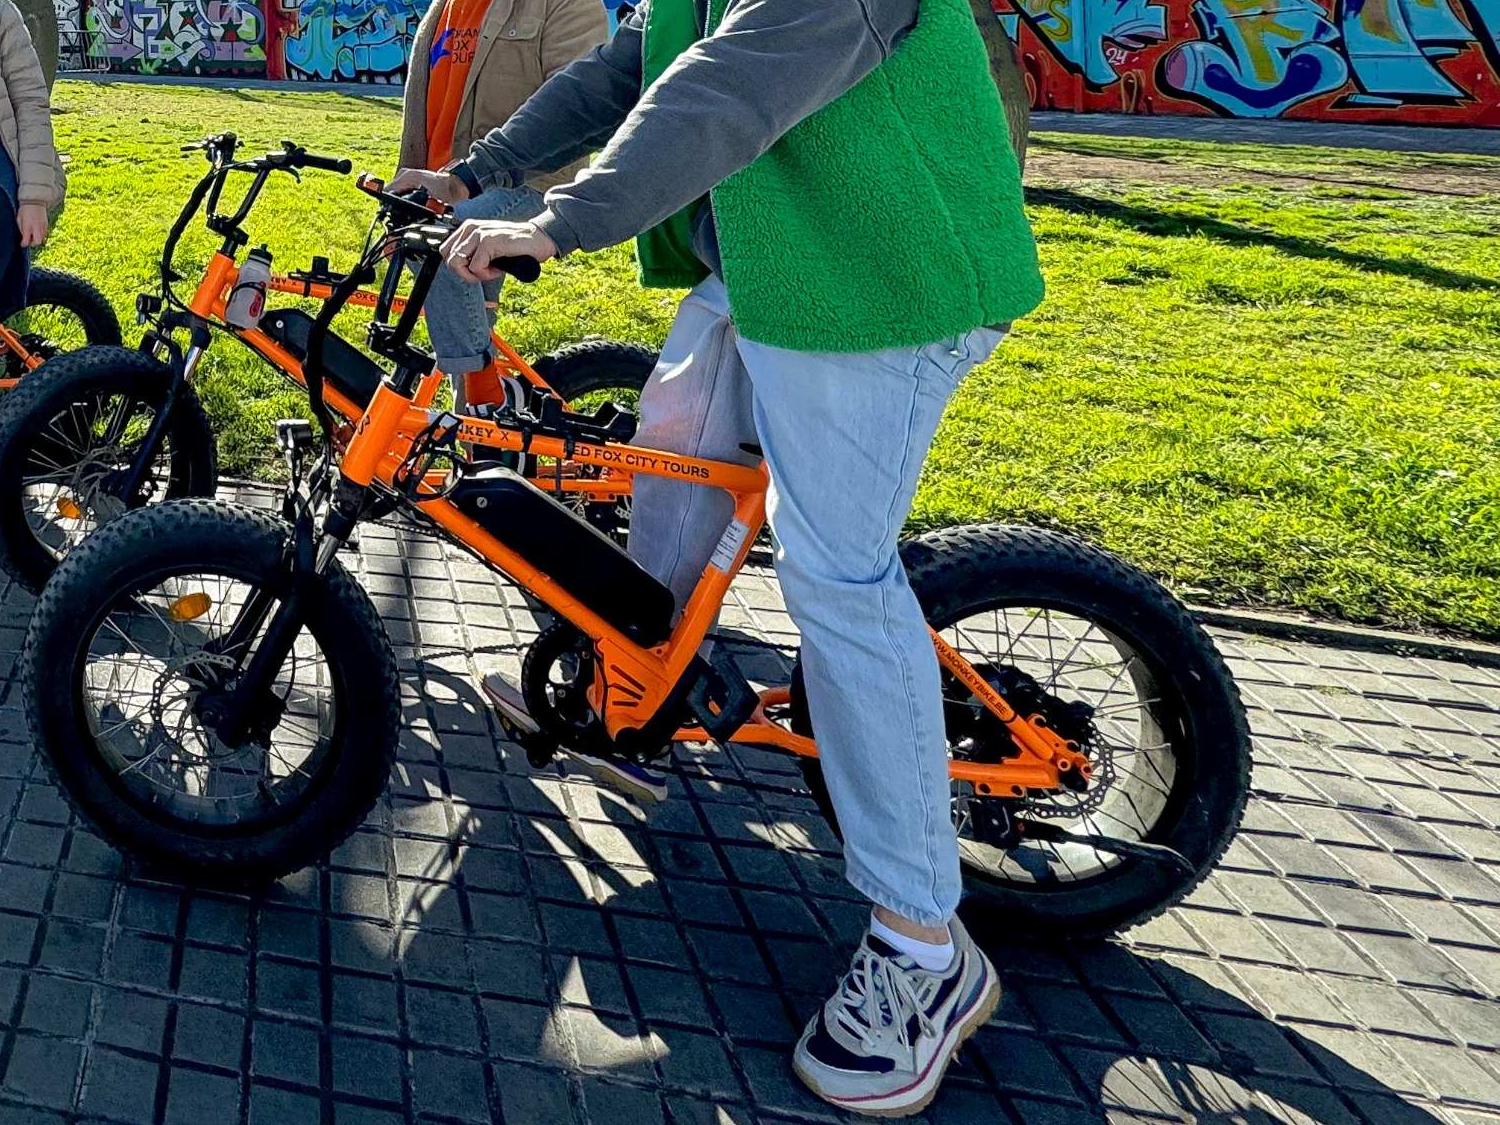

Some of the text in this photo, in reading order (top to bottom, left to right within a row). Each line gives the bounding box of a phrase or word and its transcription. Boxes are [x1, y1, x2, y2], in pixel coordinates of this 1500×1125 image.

[452, 39, 470, 51] OX
[1106, 47, 1128, 65] 24
[459, 424, 510, 441] NKEY X
[594, 449, 621, 463] FOX
[626, 454, 658, 469] CITY
[661, 460, 710, 479] TOURS
